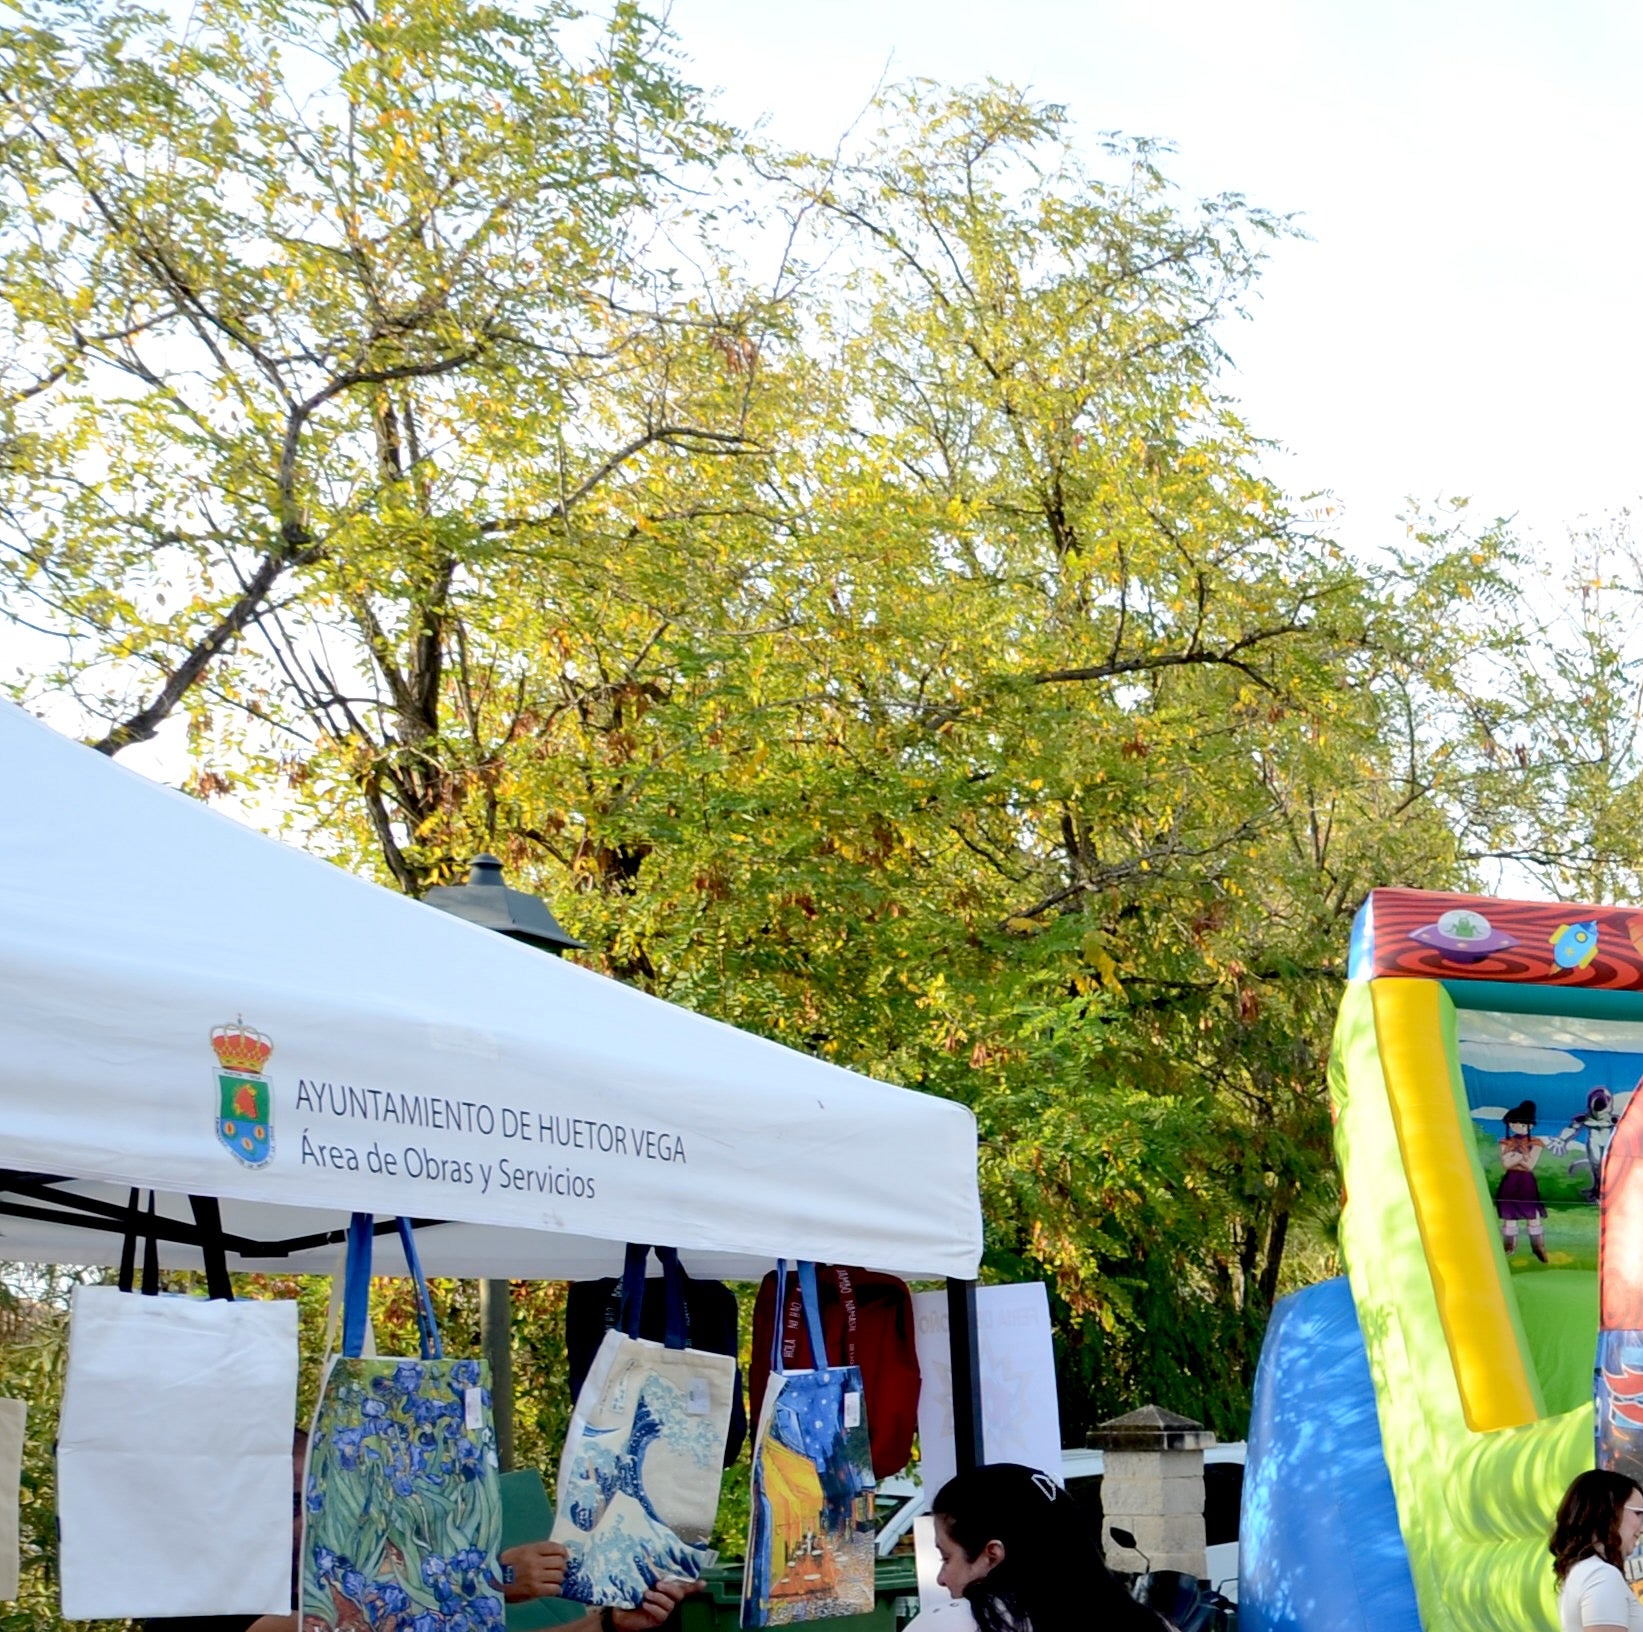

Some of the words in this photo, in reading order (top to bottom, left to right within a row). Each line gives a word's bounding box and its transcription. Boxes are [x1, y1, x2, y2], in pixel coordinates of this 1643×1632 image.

[296, 1079, 495, 1135] AYUNTAMIENTO
[503, 1109, 533, 1141] DE
[539, 1114, 627, 1155] HUETOR
[631, 1128, 687, 1164] VEGA
[301, 1128, 360, 1172] Área
[367, 1142, 398, 1176] de
[405, 1146, 473, 1184] Obras
[480, 1162, 493, 1194] y
[500, 1159, 597, 1199] Servicios
